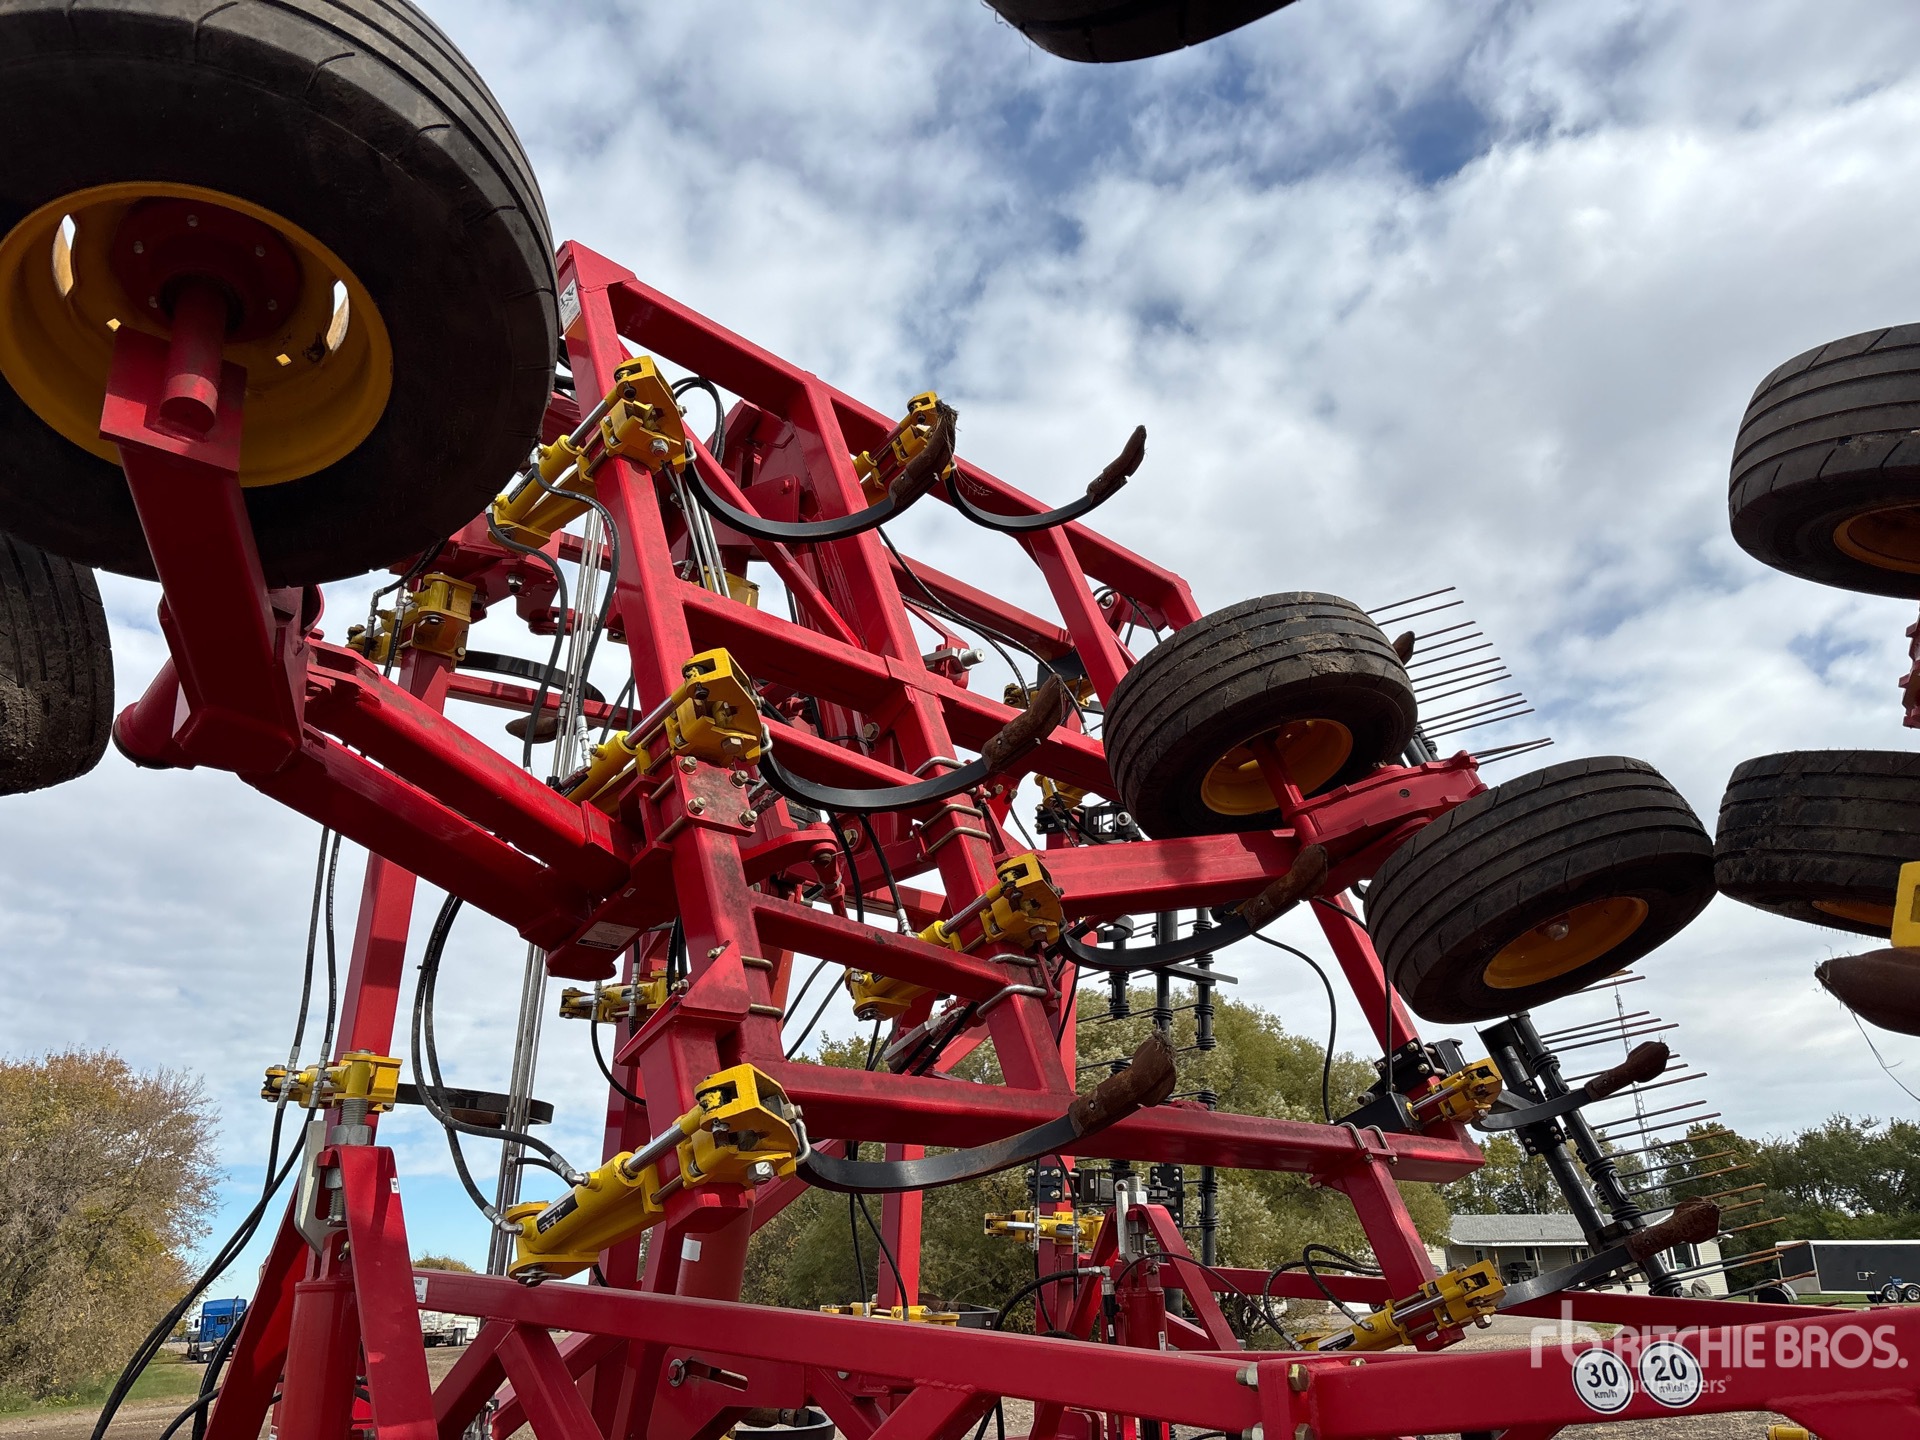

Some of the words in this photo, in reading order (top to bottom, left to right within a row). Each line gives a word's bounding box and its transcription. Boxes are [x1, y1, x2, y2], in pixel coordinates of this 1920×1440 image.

[1584, 1361, 1618, 1388] 30
[1651, 1354, 1687, 1381] 20
[1594, 1390, 1618, 1399] km/h
